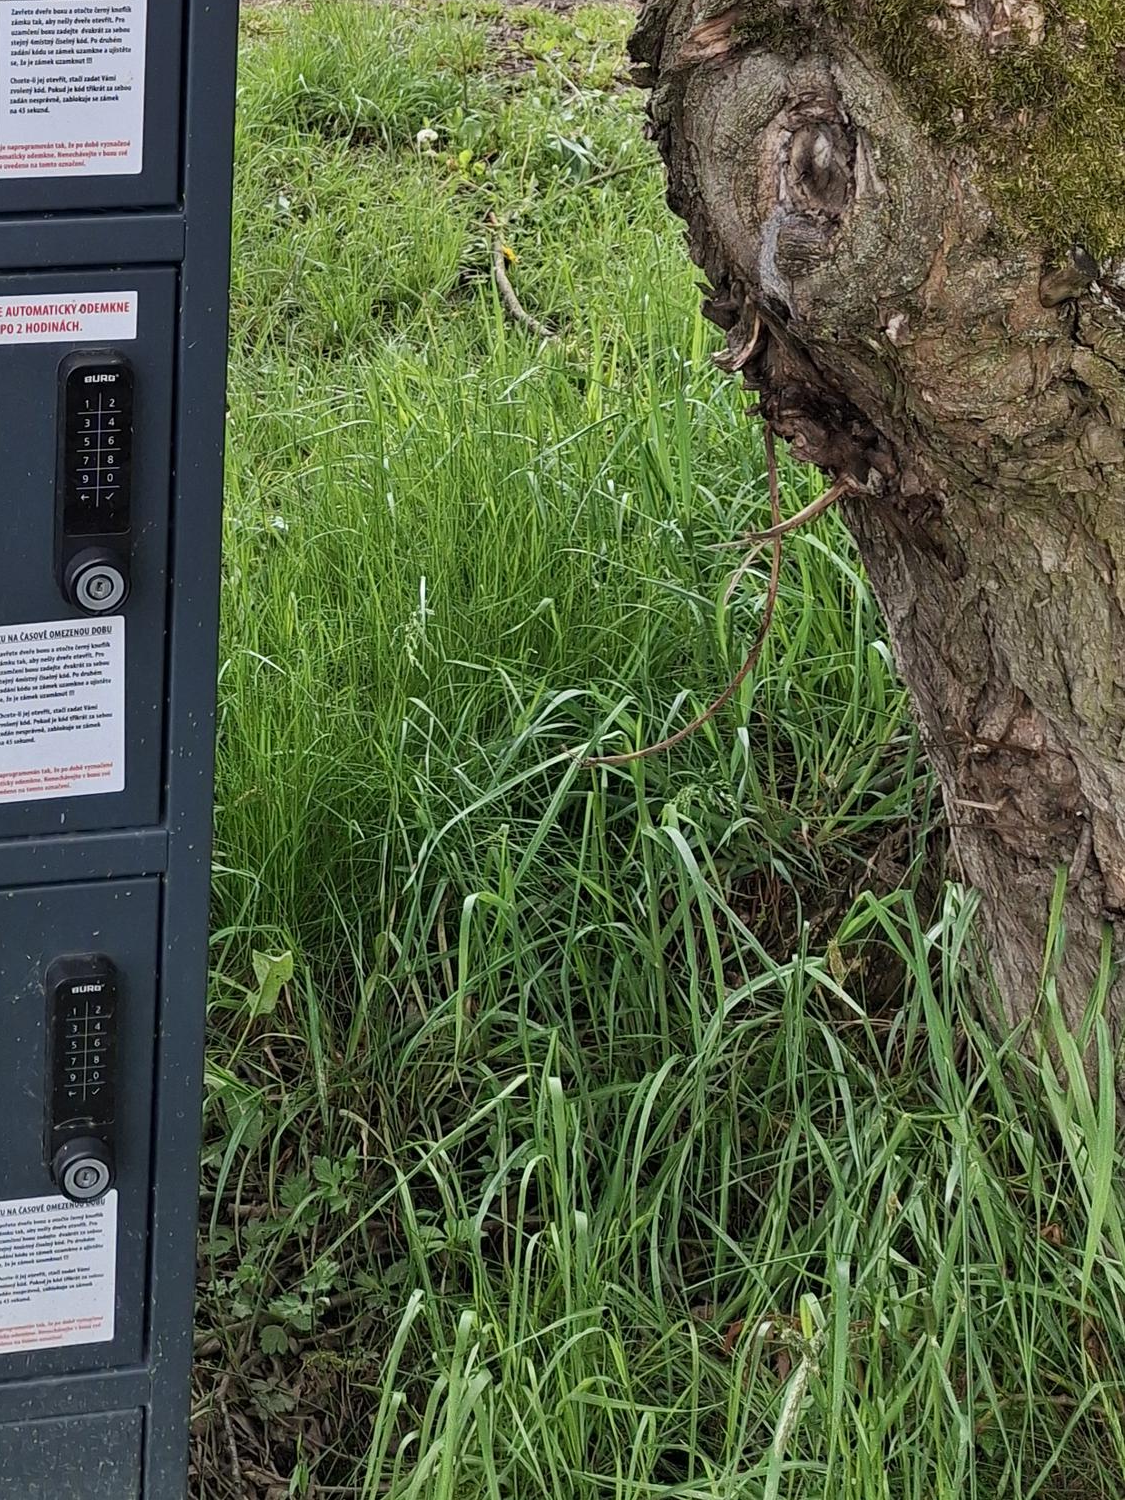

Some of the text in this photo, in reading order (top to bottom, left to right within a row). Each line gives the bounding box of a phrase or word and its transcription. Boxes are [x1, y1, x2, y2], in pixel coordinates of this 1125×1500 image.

[5, 304, 77, 317] AUTOMATICKY
[78, 302, 129, 314] ODEMKNE
[0, 320, 82, 334] PO 2 HODINÁCH.
[84, 374, 116, 383] BURG
[7, 633, 19, 642] NA
[19, 630, 48, 642] ČASOVĚ
[49, 628, 90, 639] OMEZENOU
[91, 625, 112, 635] DOBU
